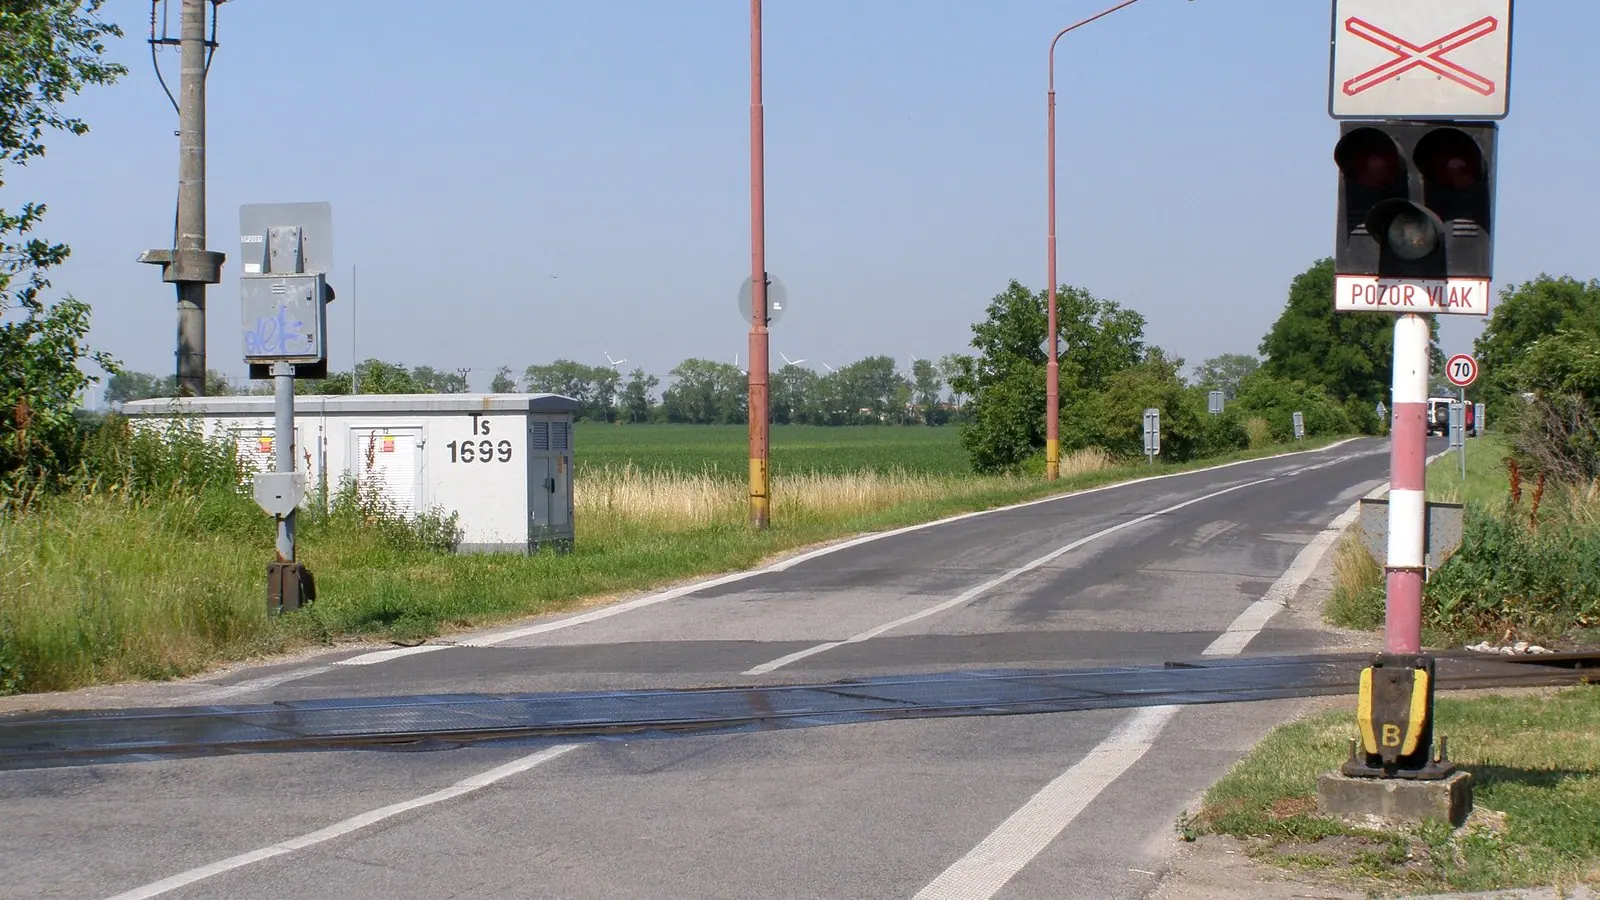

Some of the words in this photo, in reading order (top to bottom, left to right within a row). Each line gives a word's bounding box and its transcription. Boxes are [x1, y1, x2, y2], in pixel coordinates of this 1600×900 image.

[1352, 283, 1415, 306] POZOR
[1427, 285, 1473, 308] VLAK
[1454, 362, 1470, 377] 70
[468, 412, 491, 436] Ts
[446, 440, 512, 463] 1699
[1382, 724, 1400, 747] B
